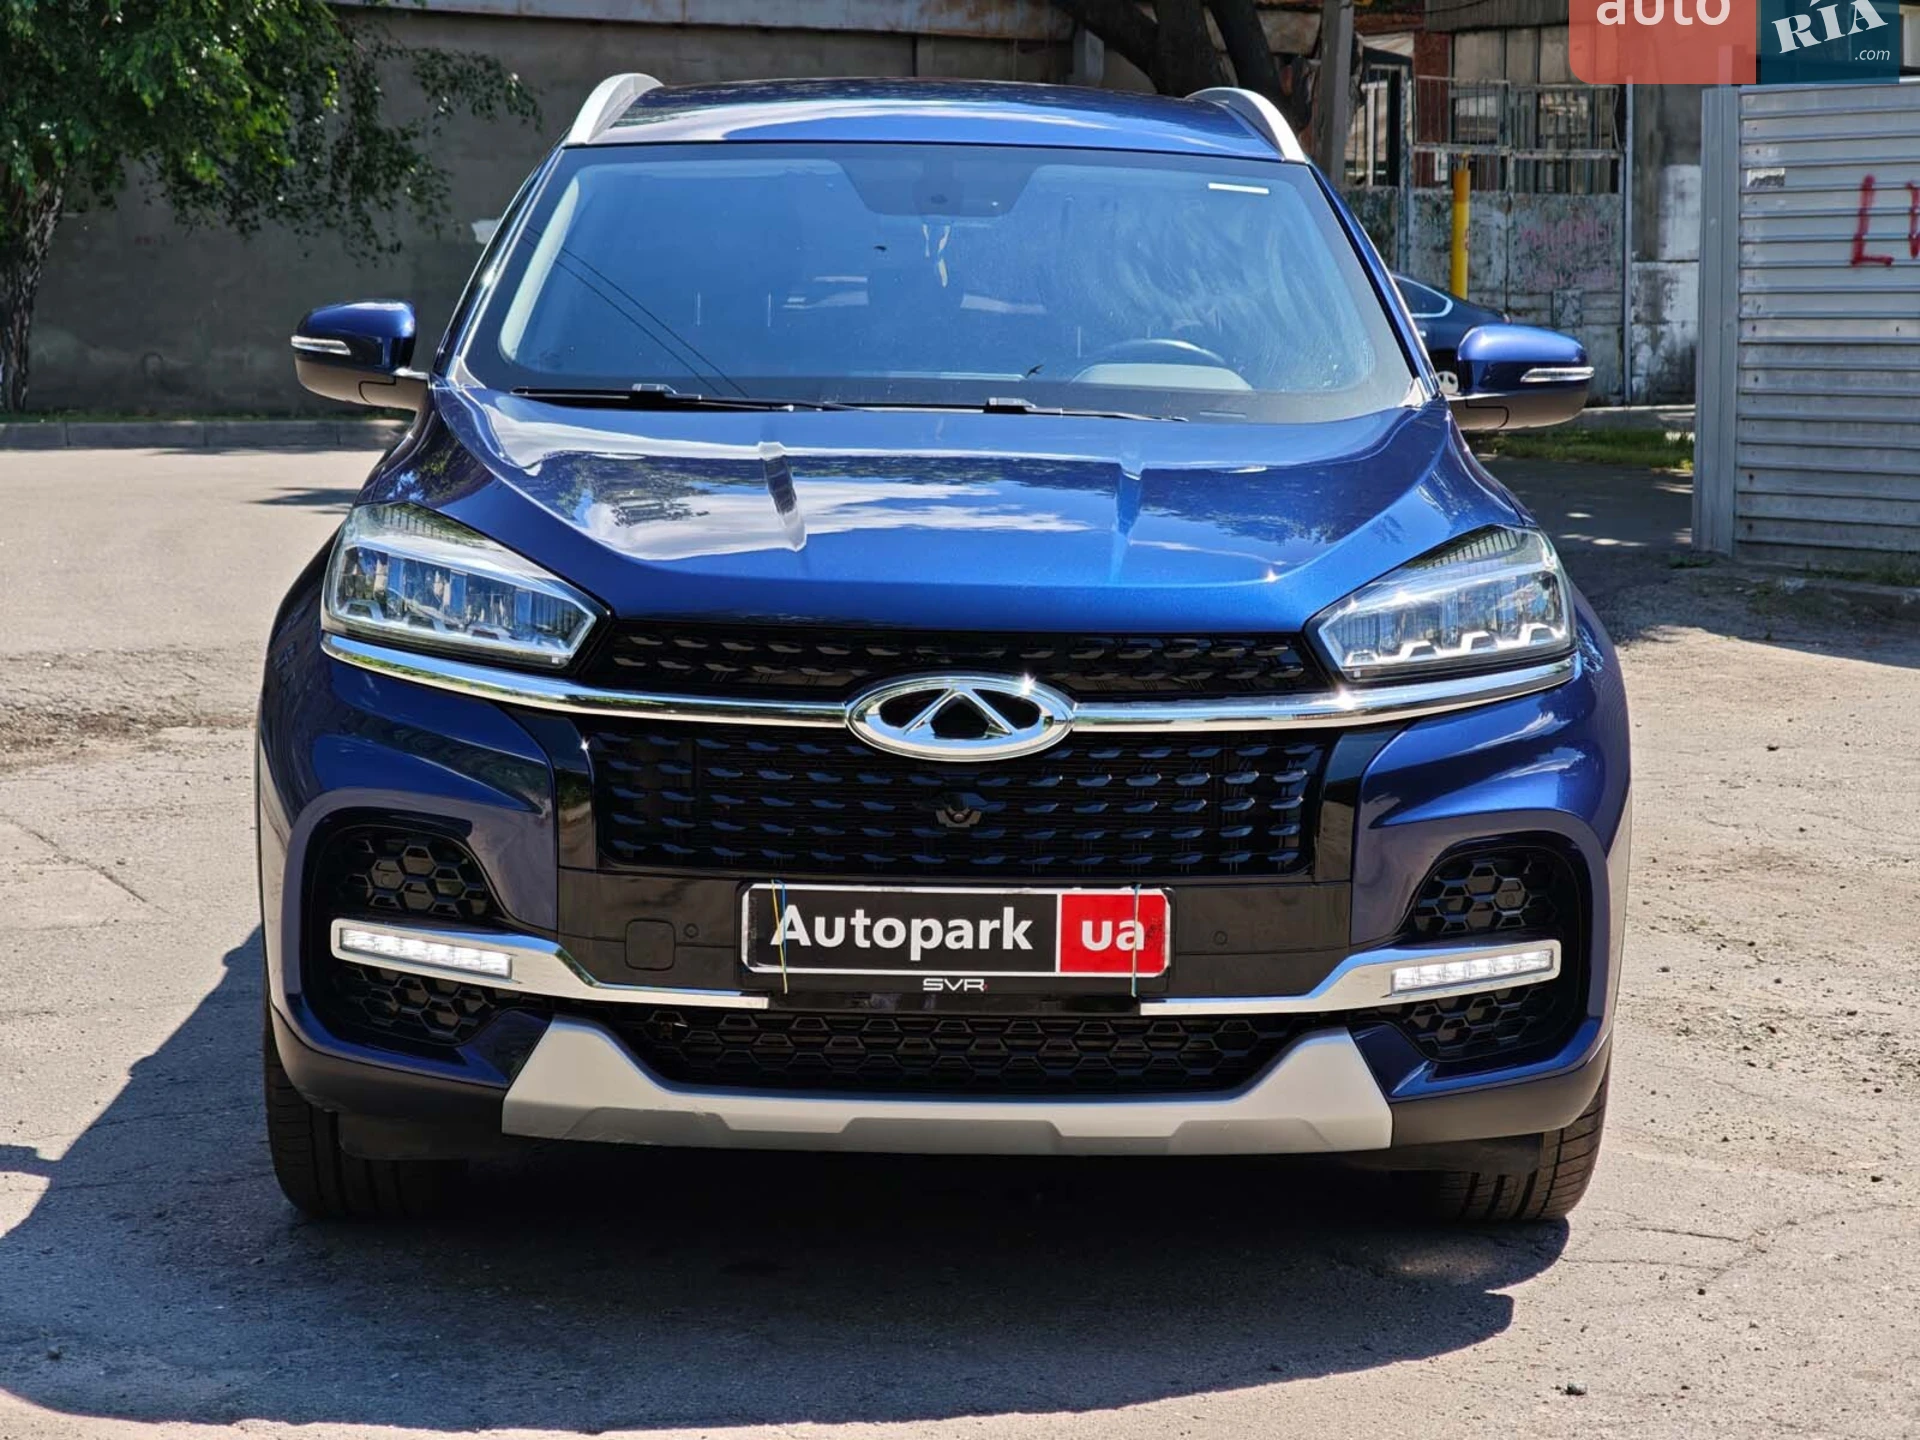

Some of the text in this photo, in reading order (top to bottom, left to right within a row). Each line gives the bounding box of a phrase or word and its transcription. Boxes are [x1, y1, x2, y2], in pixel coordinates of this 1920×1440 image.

[770, 904, 1145, 961] Autopark ua
[923, 978, 984, 991] SVR
